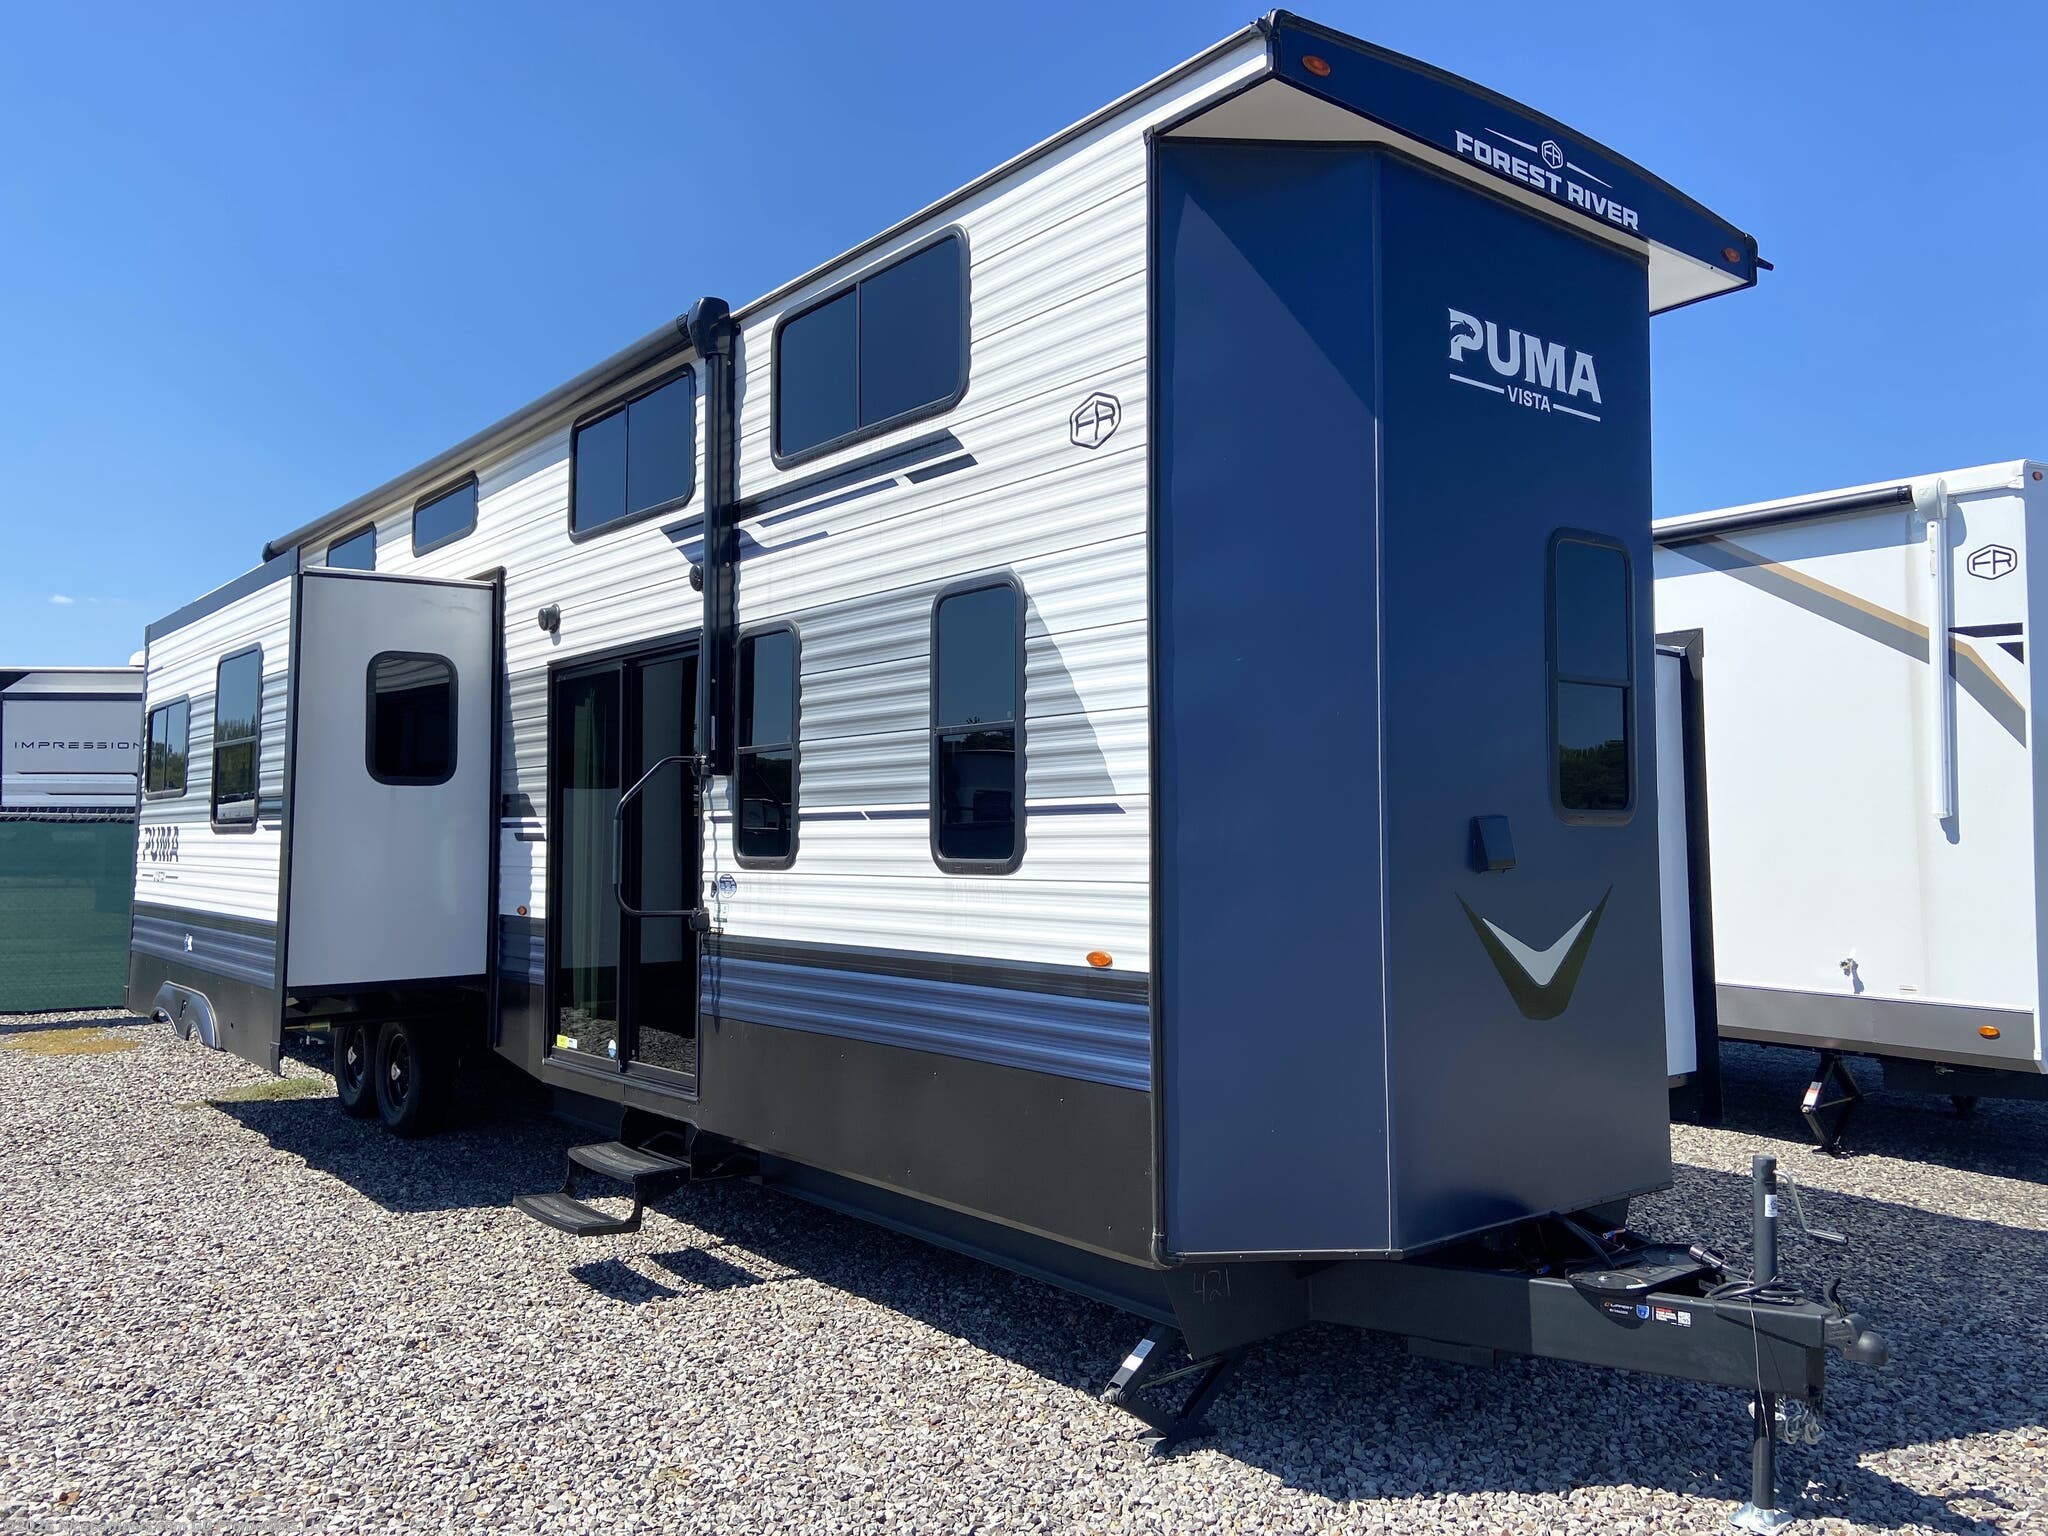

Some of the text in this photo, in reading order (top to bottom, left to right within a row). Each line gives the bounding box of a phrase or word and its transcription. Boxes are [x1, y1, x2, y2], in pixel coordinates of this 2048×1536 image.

[1455, 130, 1638, 230] FOREST RIVER
[1448, 308, 1601, 404] PUMA
[1507, 385, 1551, 413] VISTA
[142, 826, 179, 862] PUMA
